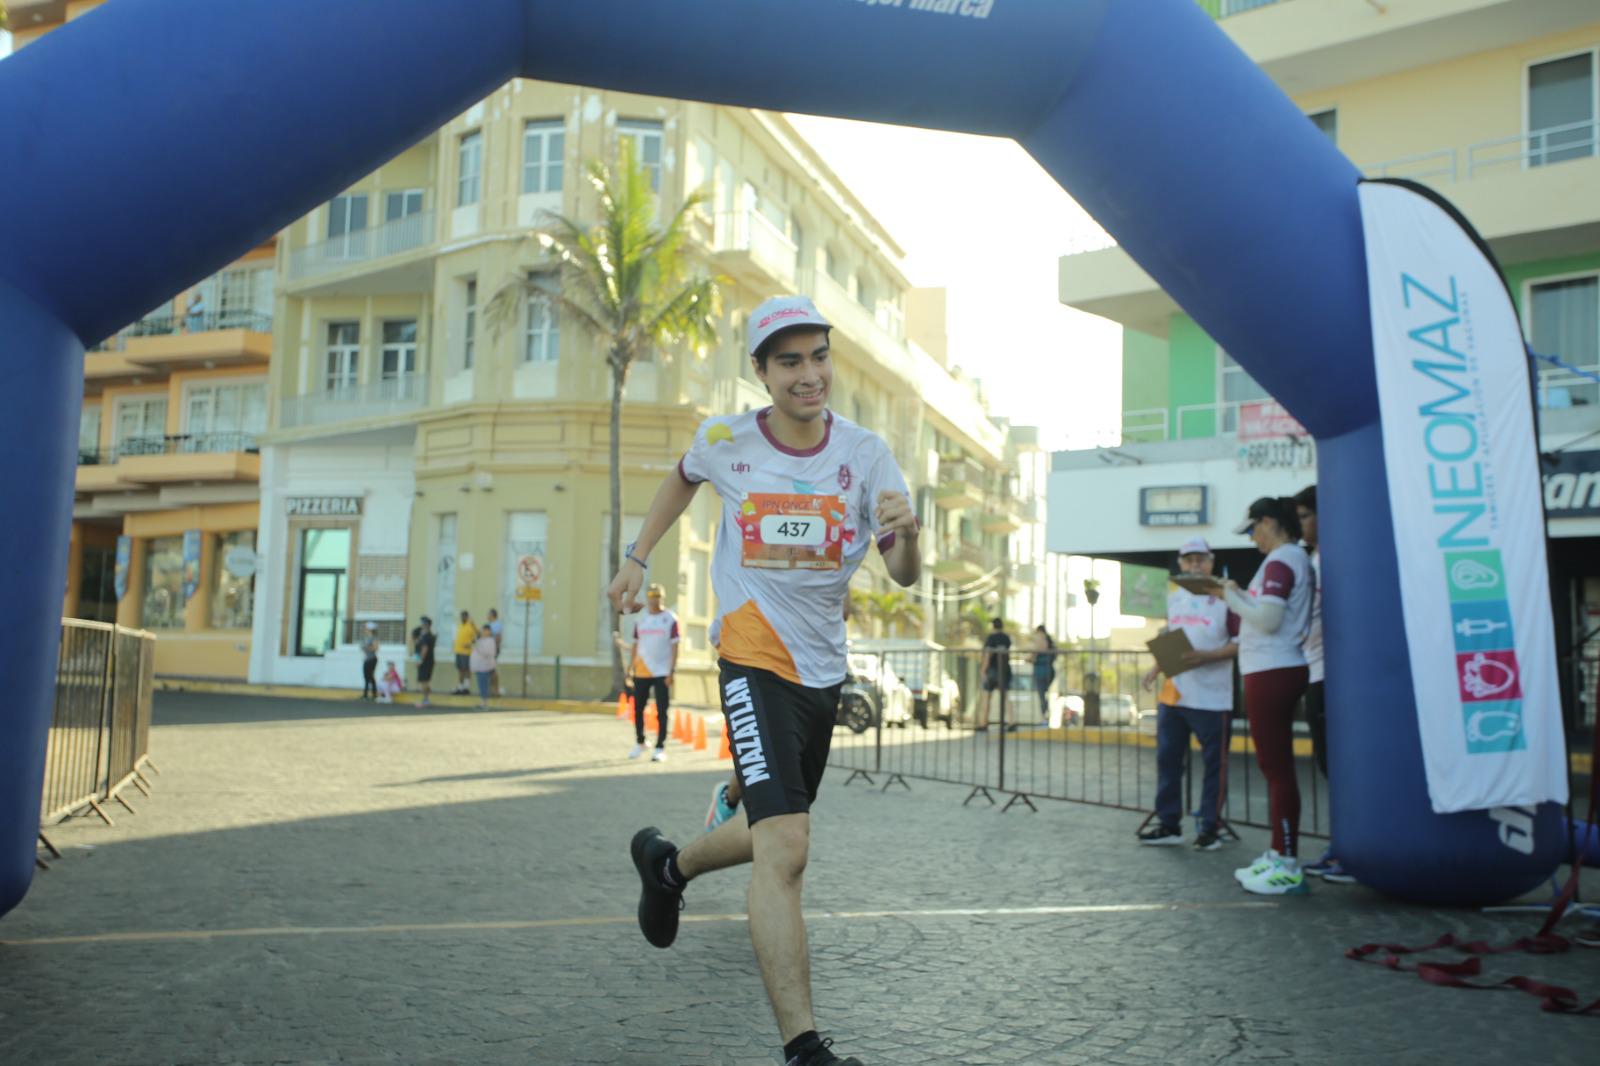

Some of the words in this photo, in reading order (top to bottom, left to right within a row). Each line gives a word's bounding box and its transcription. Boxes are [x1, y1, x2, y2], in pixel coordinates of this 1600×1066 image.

[1400, 272, 1489, 548] NEOMAZ
[287, 498, 358, 514] PIZZERIA
[777, 522, 811, 537] 437
